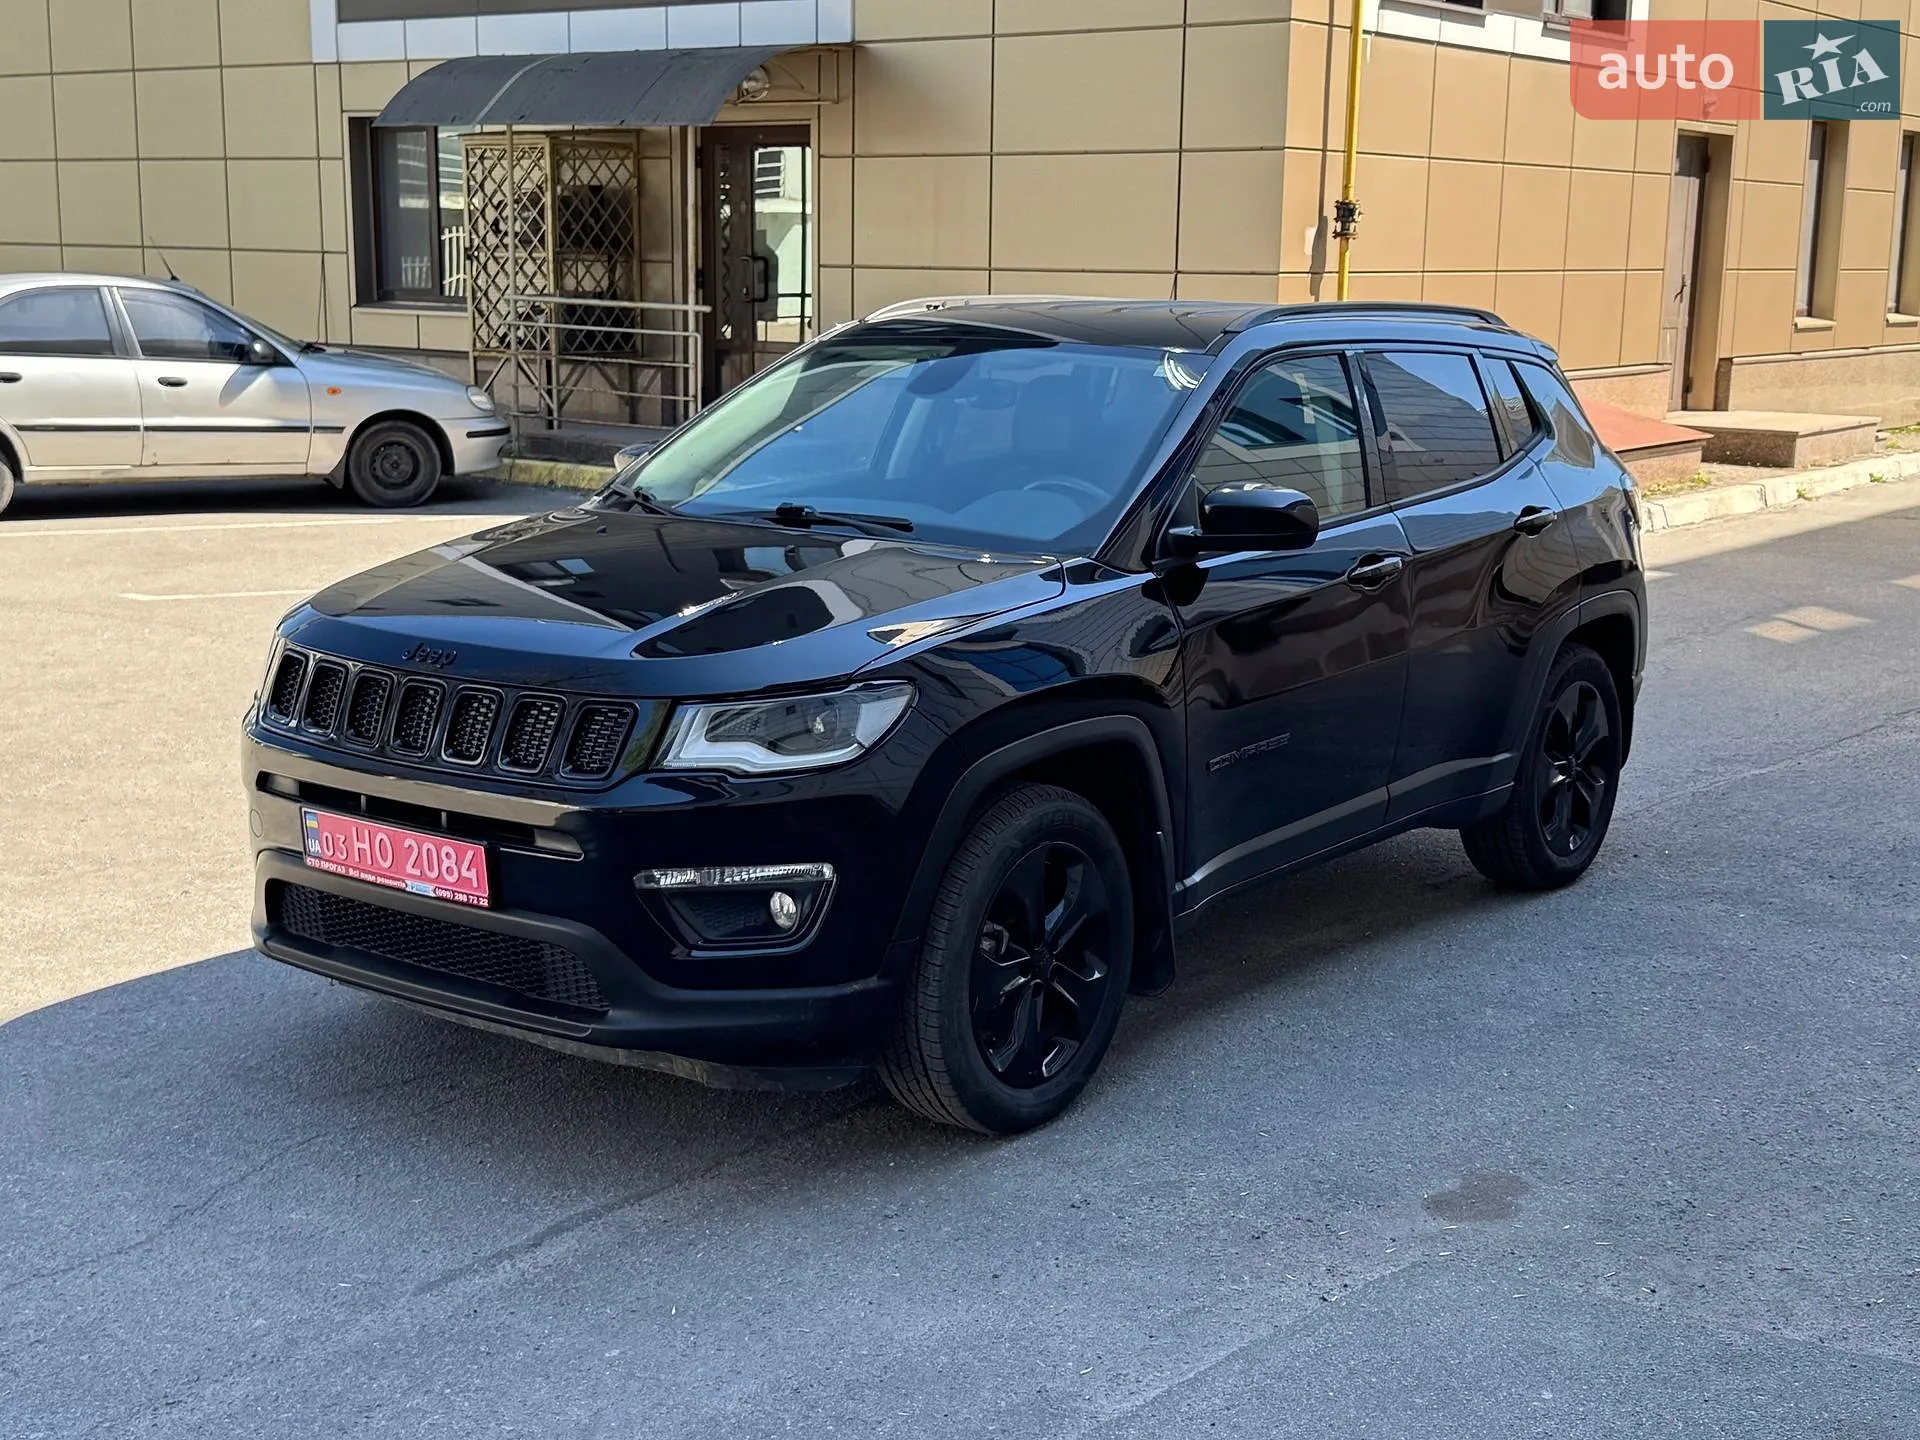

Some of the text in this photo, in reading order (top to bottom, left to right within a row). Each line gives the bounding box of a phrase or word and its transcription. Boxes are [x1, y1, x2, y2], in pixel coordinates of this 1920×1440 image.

[401, 642, 458, 669] Jeep
[308, 838, 322, 854] UA
[404, 838, 478, 888] 2084
